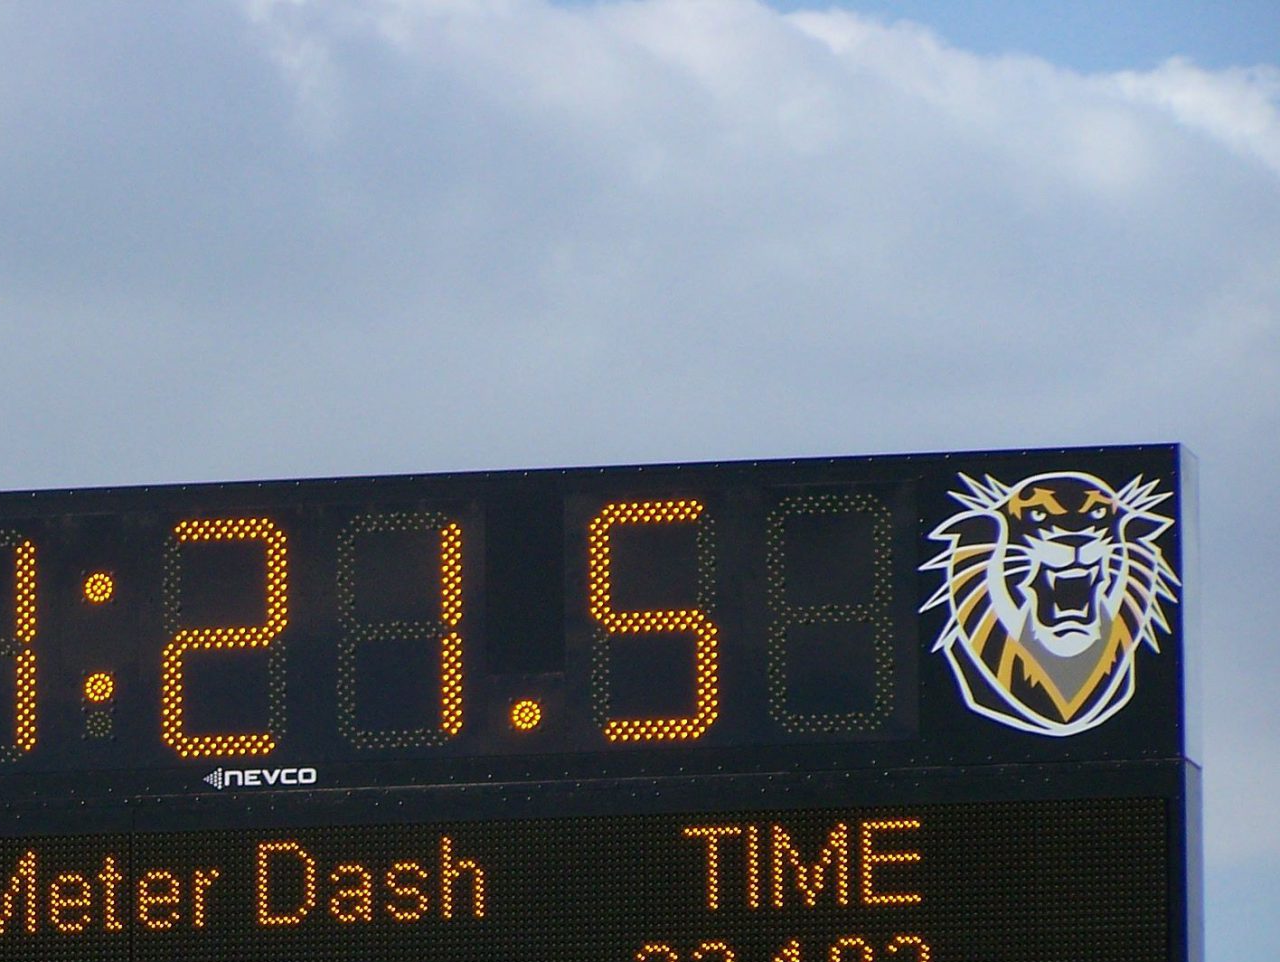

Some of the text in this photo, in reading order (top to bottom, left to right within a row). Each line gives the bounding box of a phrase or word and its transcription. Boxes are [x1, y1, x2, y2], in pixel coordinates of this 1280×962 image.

[16, 500, 718, 757] 1:21.5
[258, 836, 486, 925] Dash
[683, 820, 922, 909] TIME
